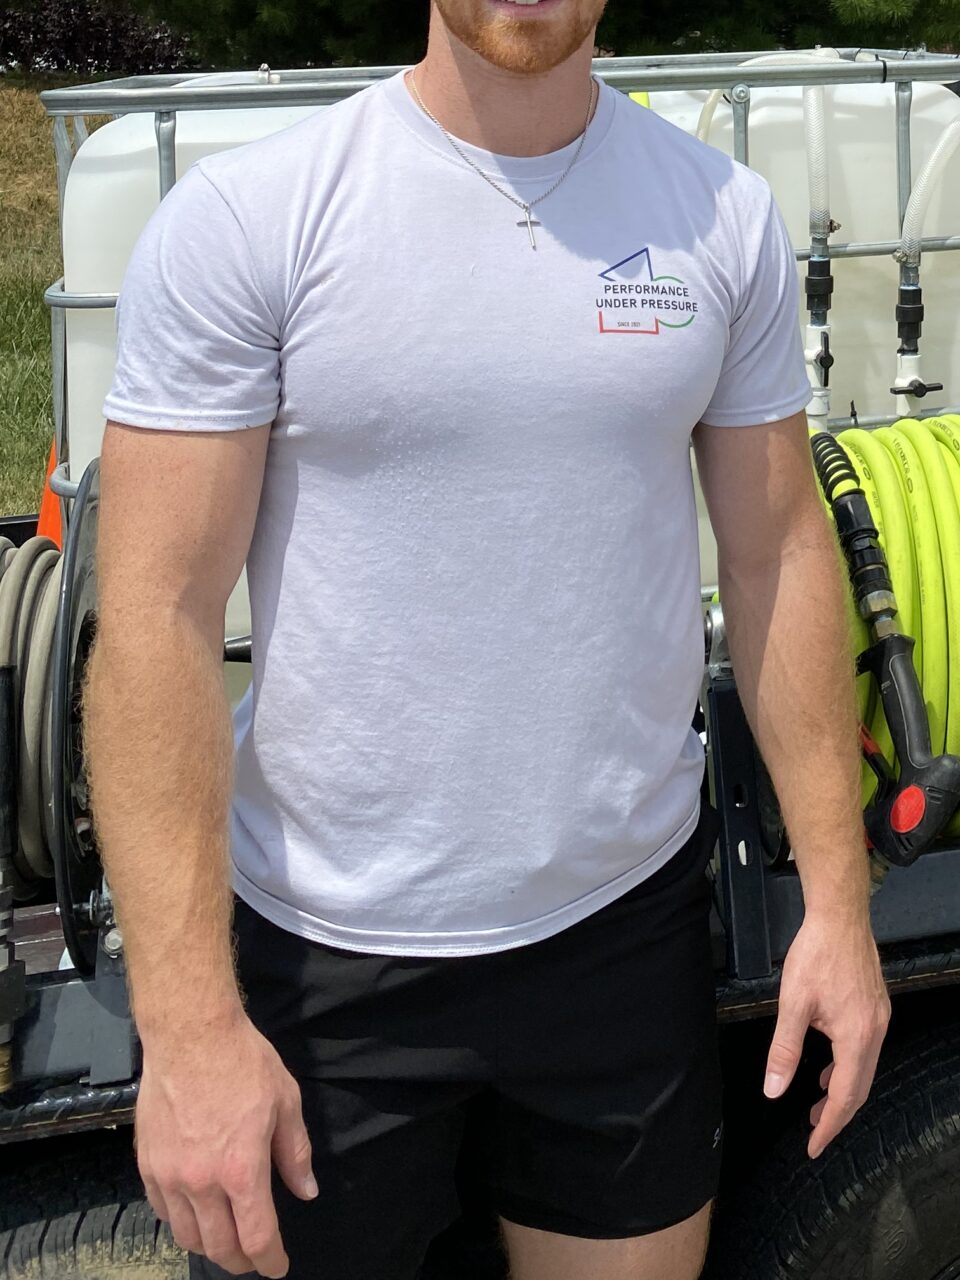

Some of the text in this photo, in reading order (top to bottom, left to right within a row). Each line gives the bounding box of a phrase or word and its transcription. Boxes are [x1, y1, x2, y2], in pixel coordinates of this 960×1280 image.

[604, 284, 689, 297] PERFORMANCE
[596, 298, 698, 312] UNDER PRESSURE
